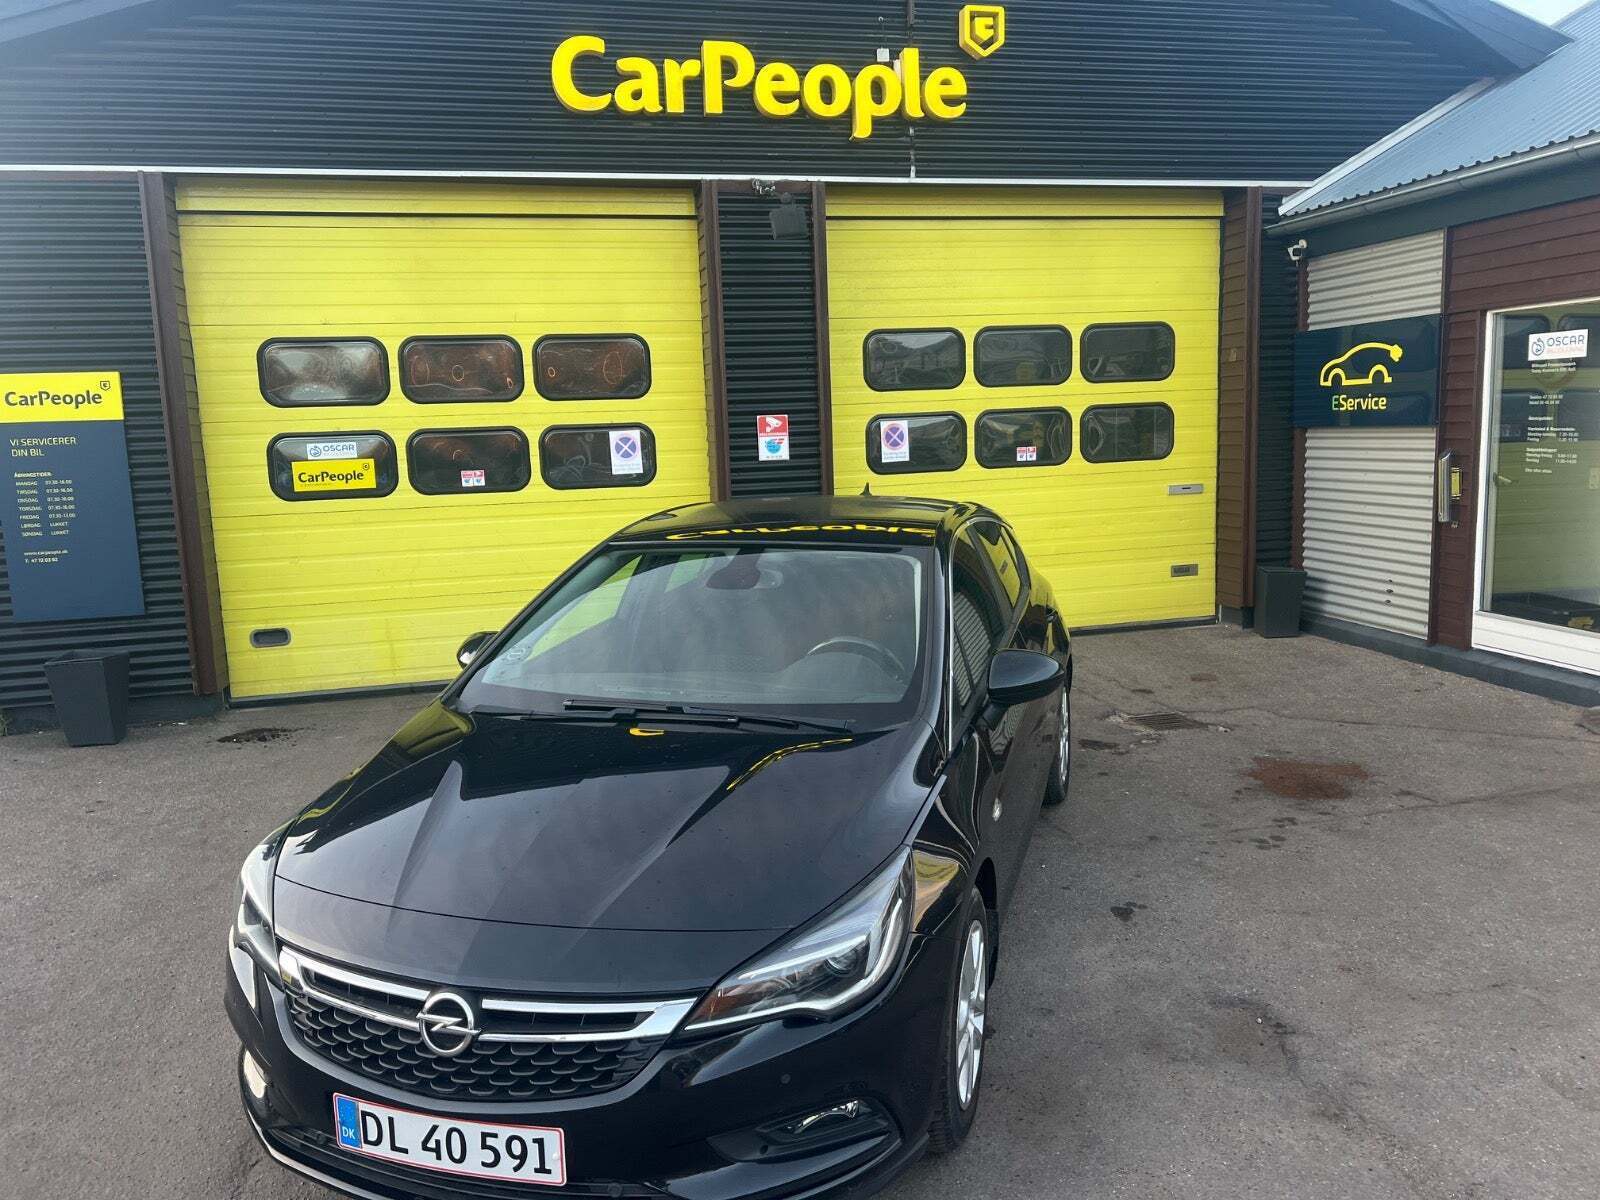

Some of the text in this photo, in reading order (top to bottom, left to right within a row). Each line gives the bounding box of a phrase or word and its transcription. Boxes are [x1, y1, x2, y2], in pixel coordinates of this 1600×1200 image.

[551, 34, 968, 141] CarPeople
[1546, 334, 1585, 347] OSCAR
[4, 390, 102, 409] CarPeople
[1331, 394, 1387, 411] EService
[20, 436, 77, 447] SERVICERER
[11, 448, 45, 457] DIN BIL
[298, 470, 364, 484] CarPeople
[342, 1126, 356, 1140] DK
[361, 1110, 552, 1175] DL 40 591
